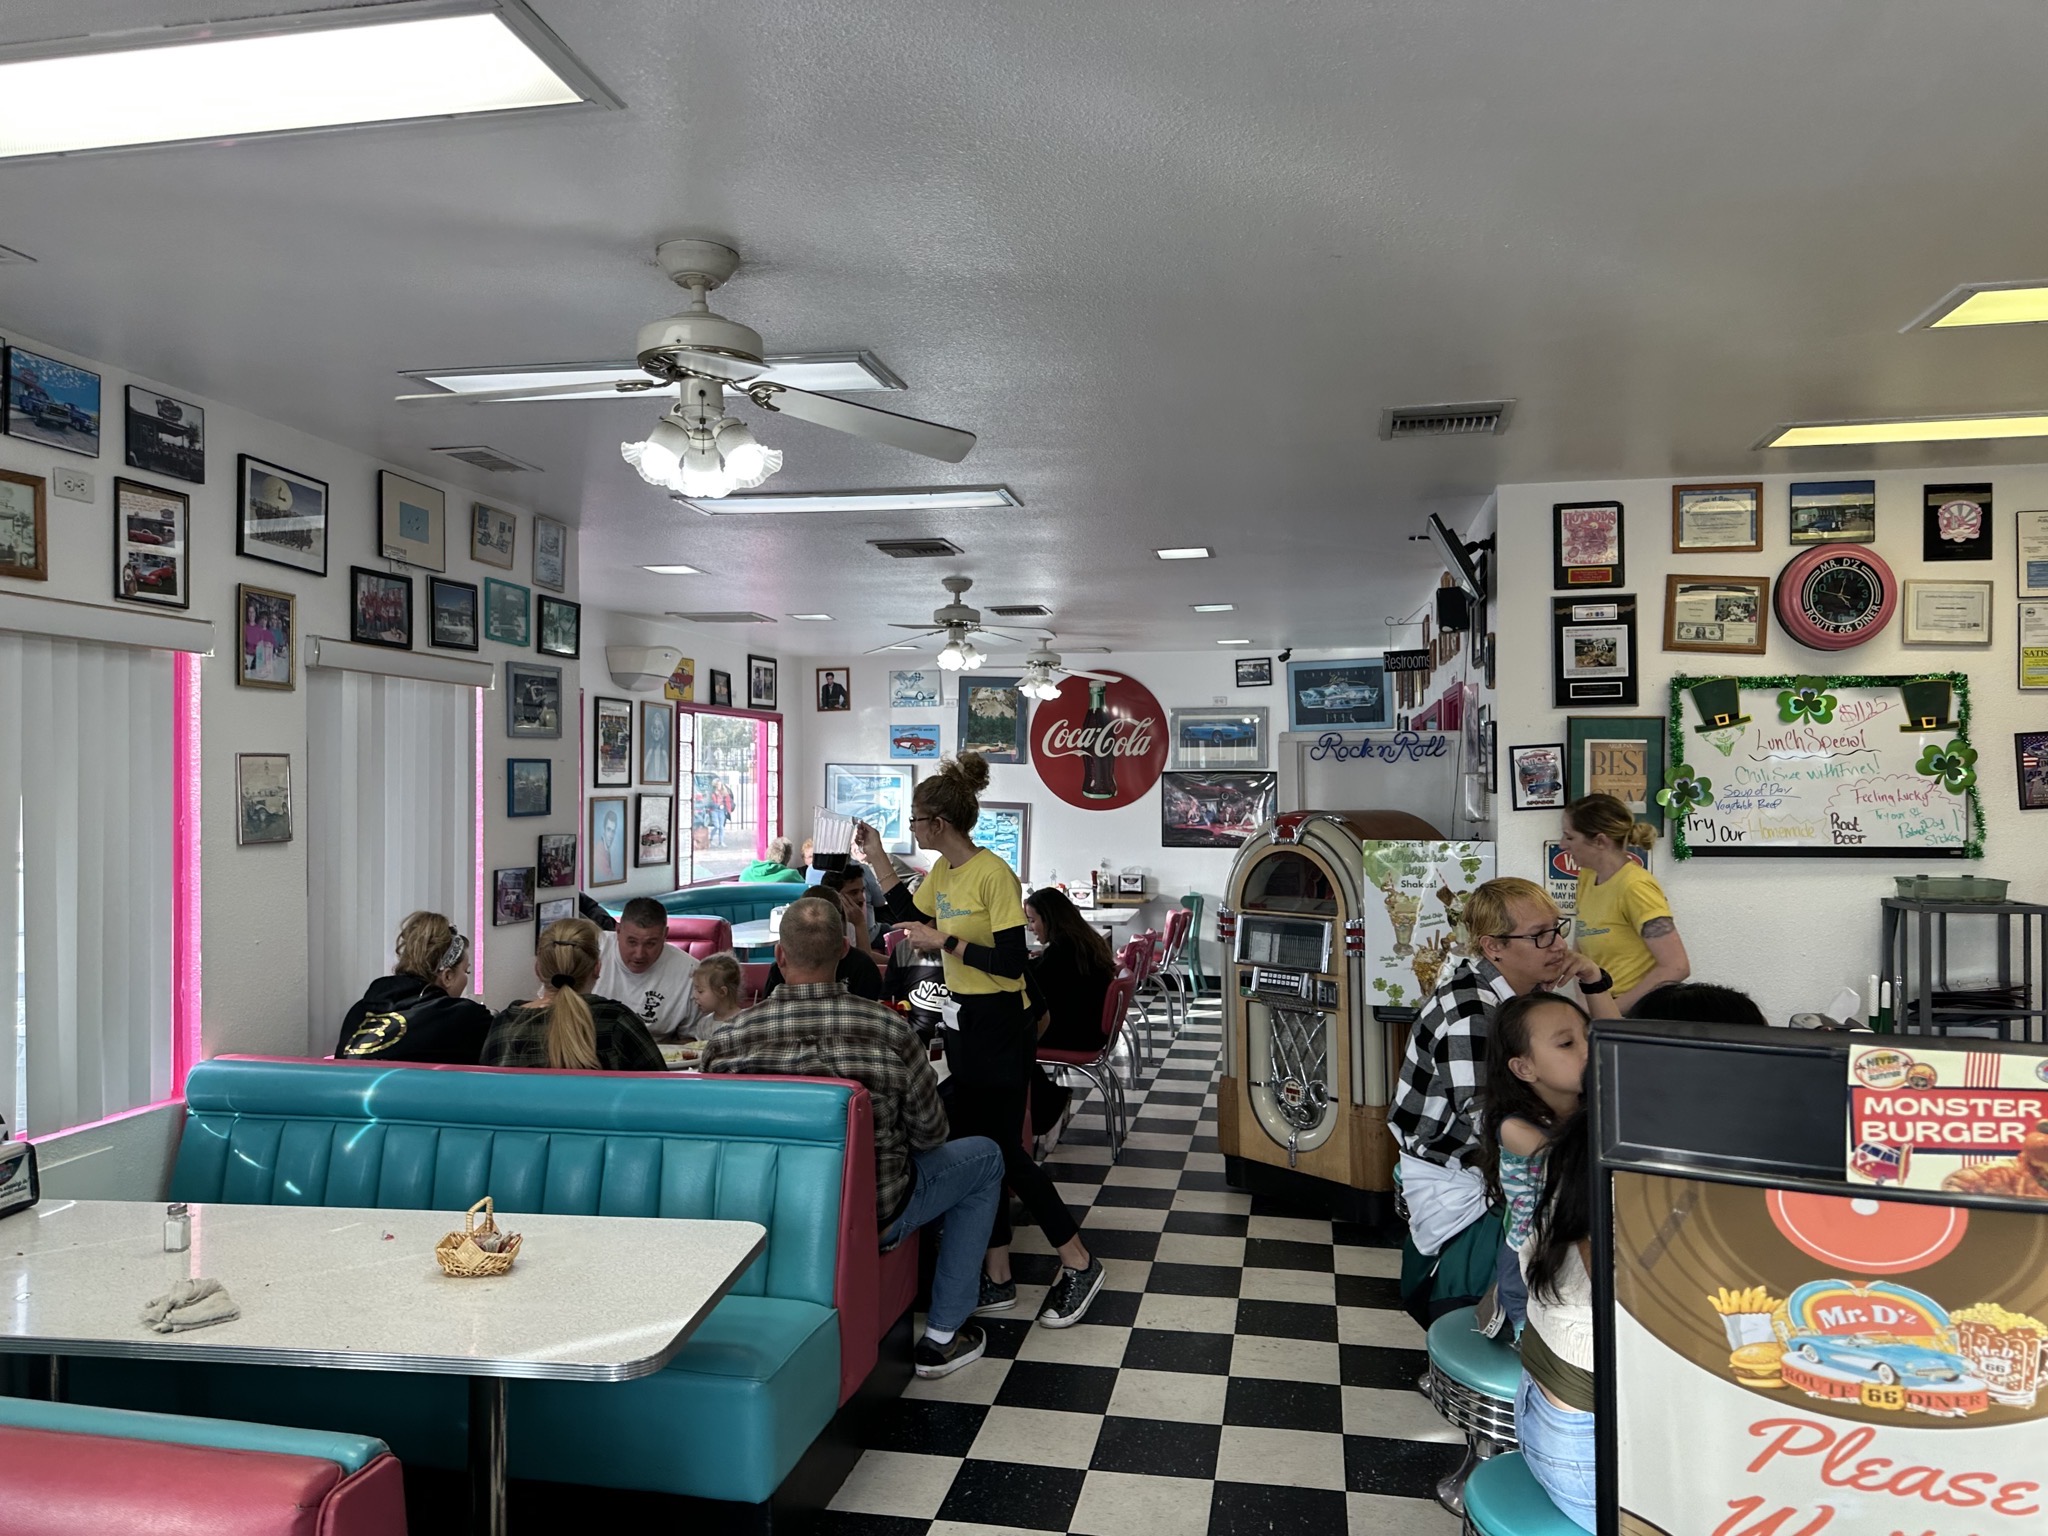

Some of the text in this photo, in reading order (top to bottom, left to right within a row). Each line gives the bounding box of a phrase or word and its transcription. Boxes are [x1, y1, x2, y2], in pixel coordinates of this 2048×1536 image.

[1819, 558, 1861, 572] MR. D'Z
[1806, 604, 1881, 634] ROUTE 66 DINER
[1384, 651, 1430, 670] Restrooms
[892, 700, 938, 708] CORVETTE
[1041, 717, 1156, 758] Coca-Cola
[1310, 732, 1374, 762] Rock
[1383, 732, 1447, 763] Roll
[1804, 727, 1867, 754] Special
[1591, 750, 1647, 776] BEST
[1723, 785, 1753, 798] Soup
[1850, 786, 1896, 807] Feeling
[1685, 812, 1717, 843] Try
[1830, 812, 1863, 832] Root
[1377, 840, 1424, 849] Featured
[1832, 830, 1867, 845] Beer
[1402, 864, 1427, 879] Day
[1401, 880, 1437, 888] Shakes!
[645, 990, 665, 1001] FELIX
[1866, 1055, 1900, 1067] NEVER
[1863, 1096, 2043, 1118] MONSTER
[1861, 1121, 2027, 1144] BURGER
[1817, 1304, 1918, 1329] Mr. D'z
[1985, 1363, 2006, 1373] 66
[1784, 1367, 1981, 1408] ROUTE 66 DINER
[1746, 1418, 2041, 1516] Please
